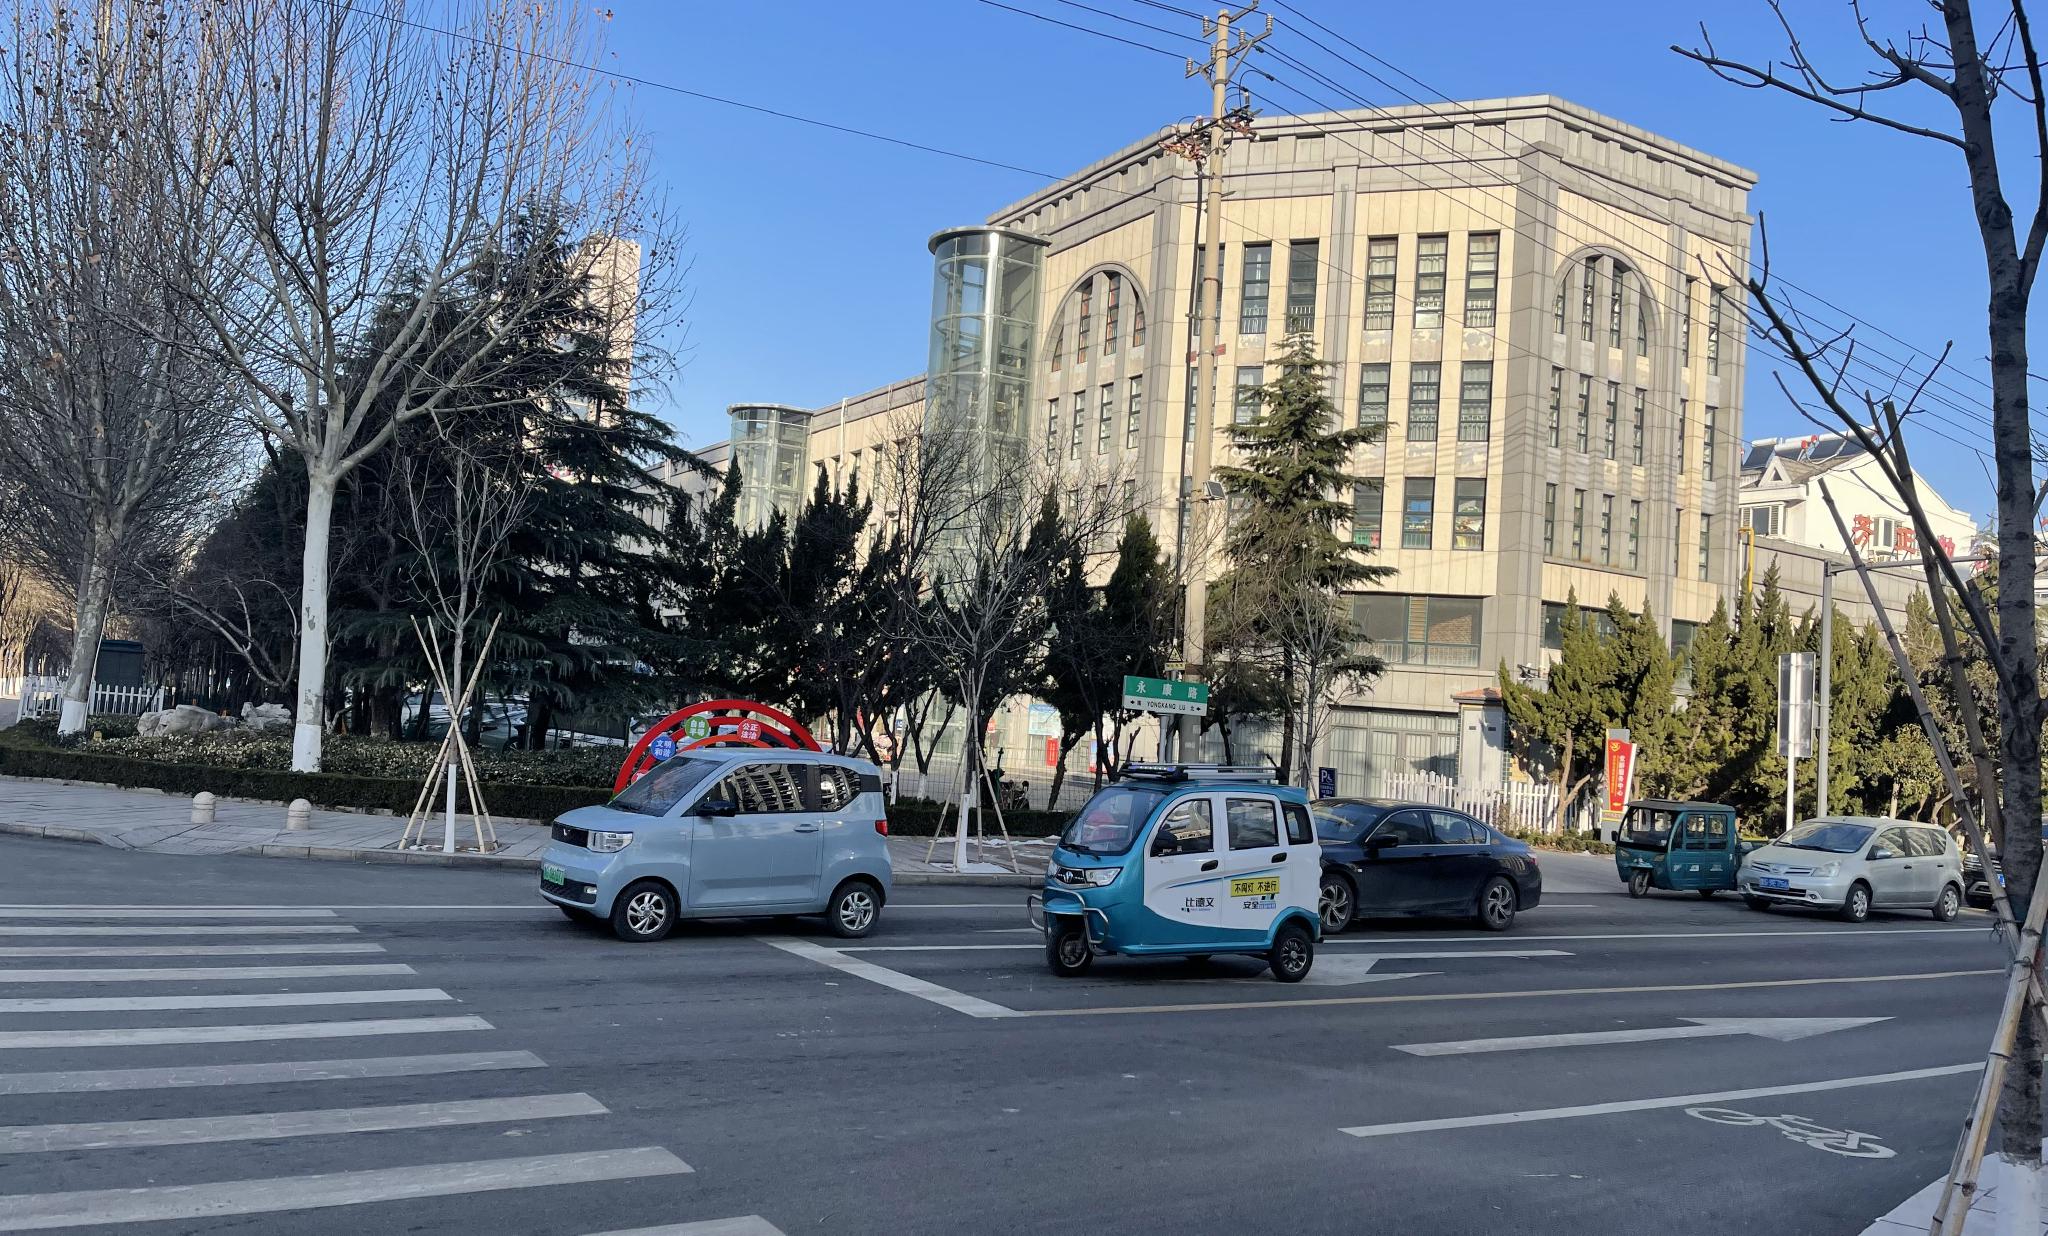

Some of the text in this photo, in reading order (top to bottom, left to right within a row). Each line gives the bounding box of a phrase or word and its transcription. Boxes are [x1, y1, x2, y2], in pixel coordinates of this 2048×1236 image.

[1136, 681, 1198, 699] 永康路
[1147, 701, 1176, 710] YONGKANG
[691, 720, 705, 728] 自由
[742, 722, 757, 732] 公正
[741, 730, 757, 740] 法治
[656, 740, 672, 748] 文明
[654, 747, 671, 758] 和谐
[1234, 881, 1277, 893] 不闯灯 不逆行
[1185, 897, 1214, 908] 比德文
